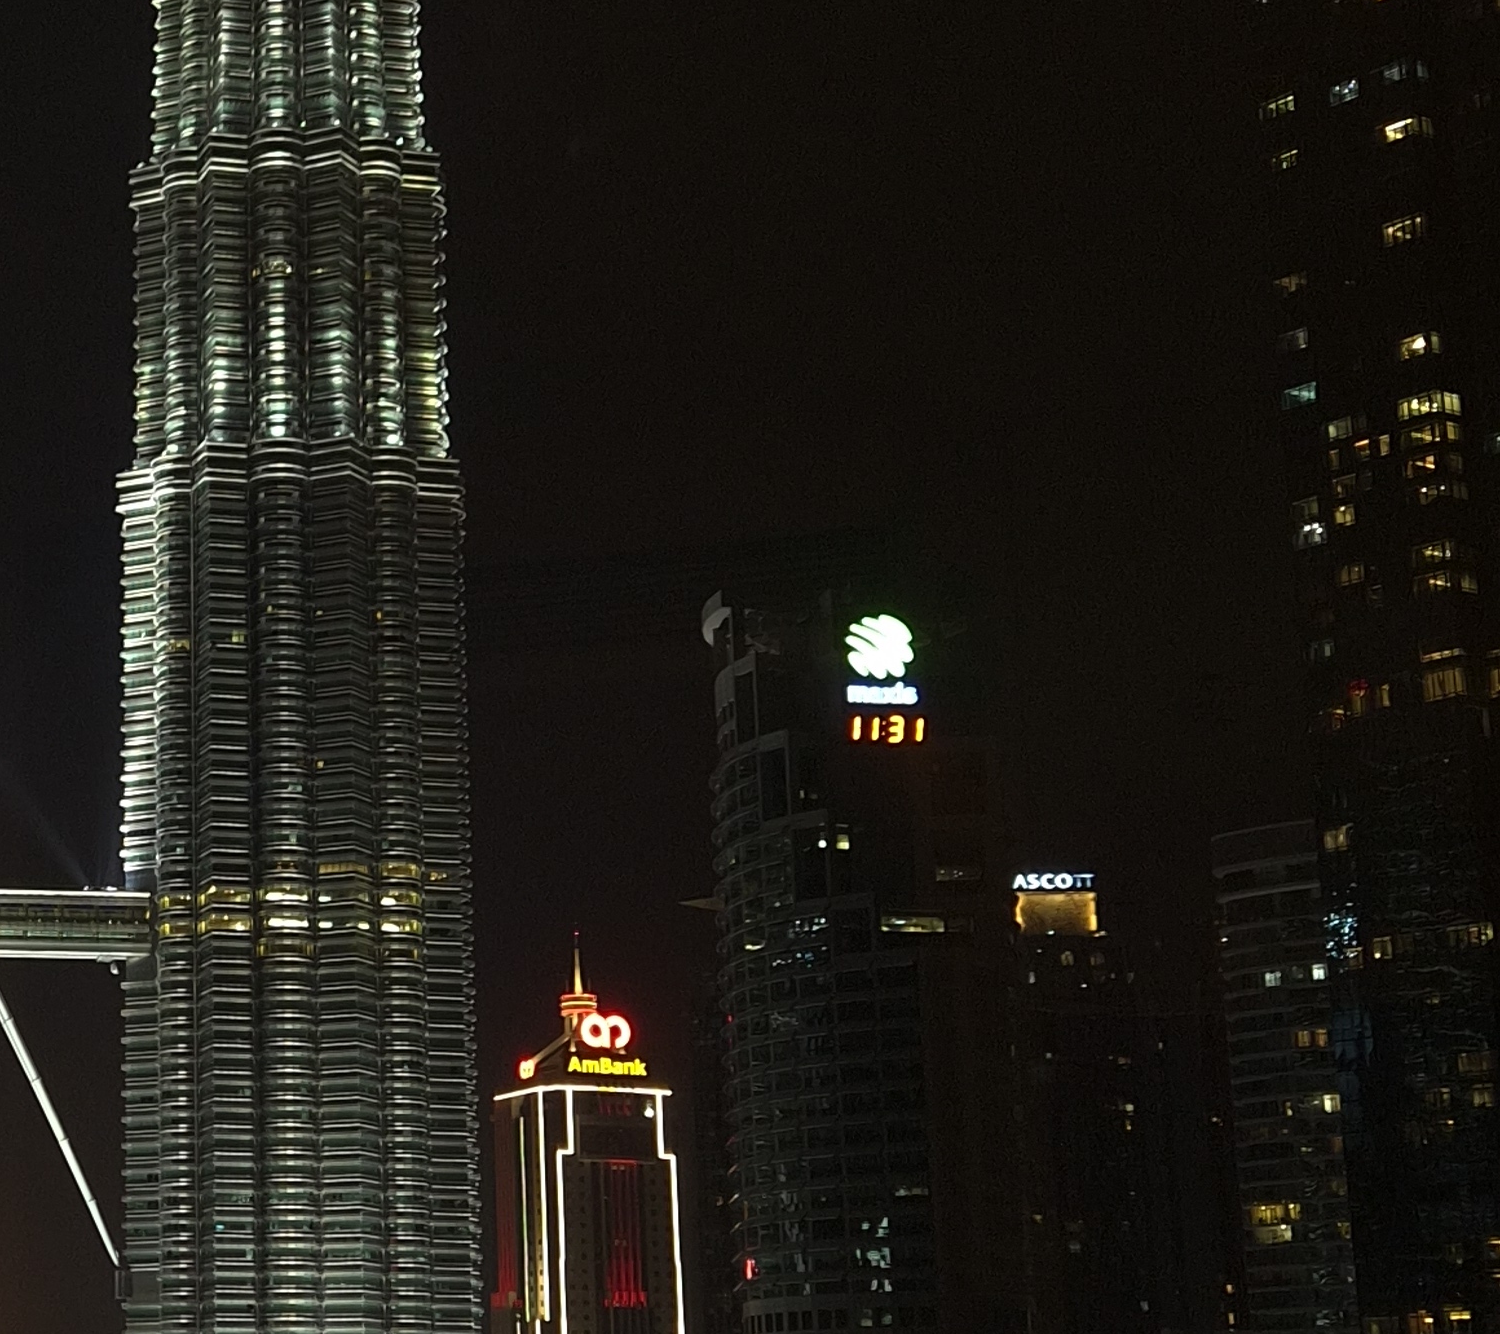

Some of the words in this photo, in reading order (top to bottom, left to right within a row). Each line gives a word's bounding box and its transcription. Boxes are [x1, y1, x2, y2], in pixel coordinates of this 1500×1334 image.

[852, 715, 925, 744] 11:31
[1012, 872, 1095, 890] ASCOTT
[568, 1056, 647, 1077] AmBank
